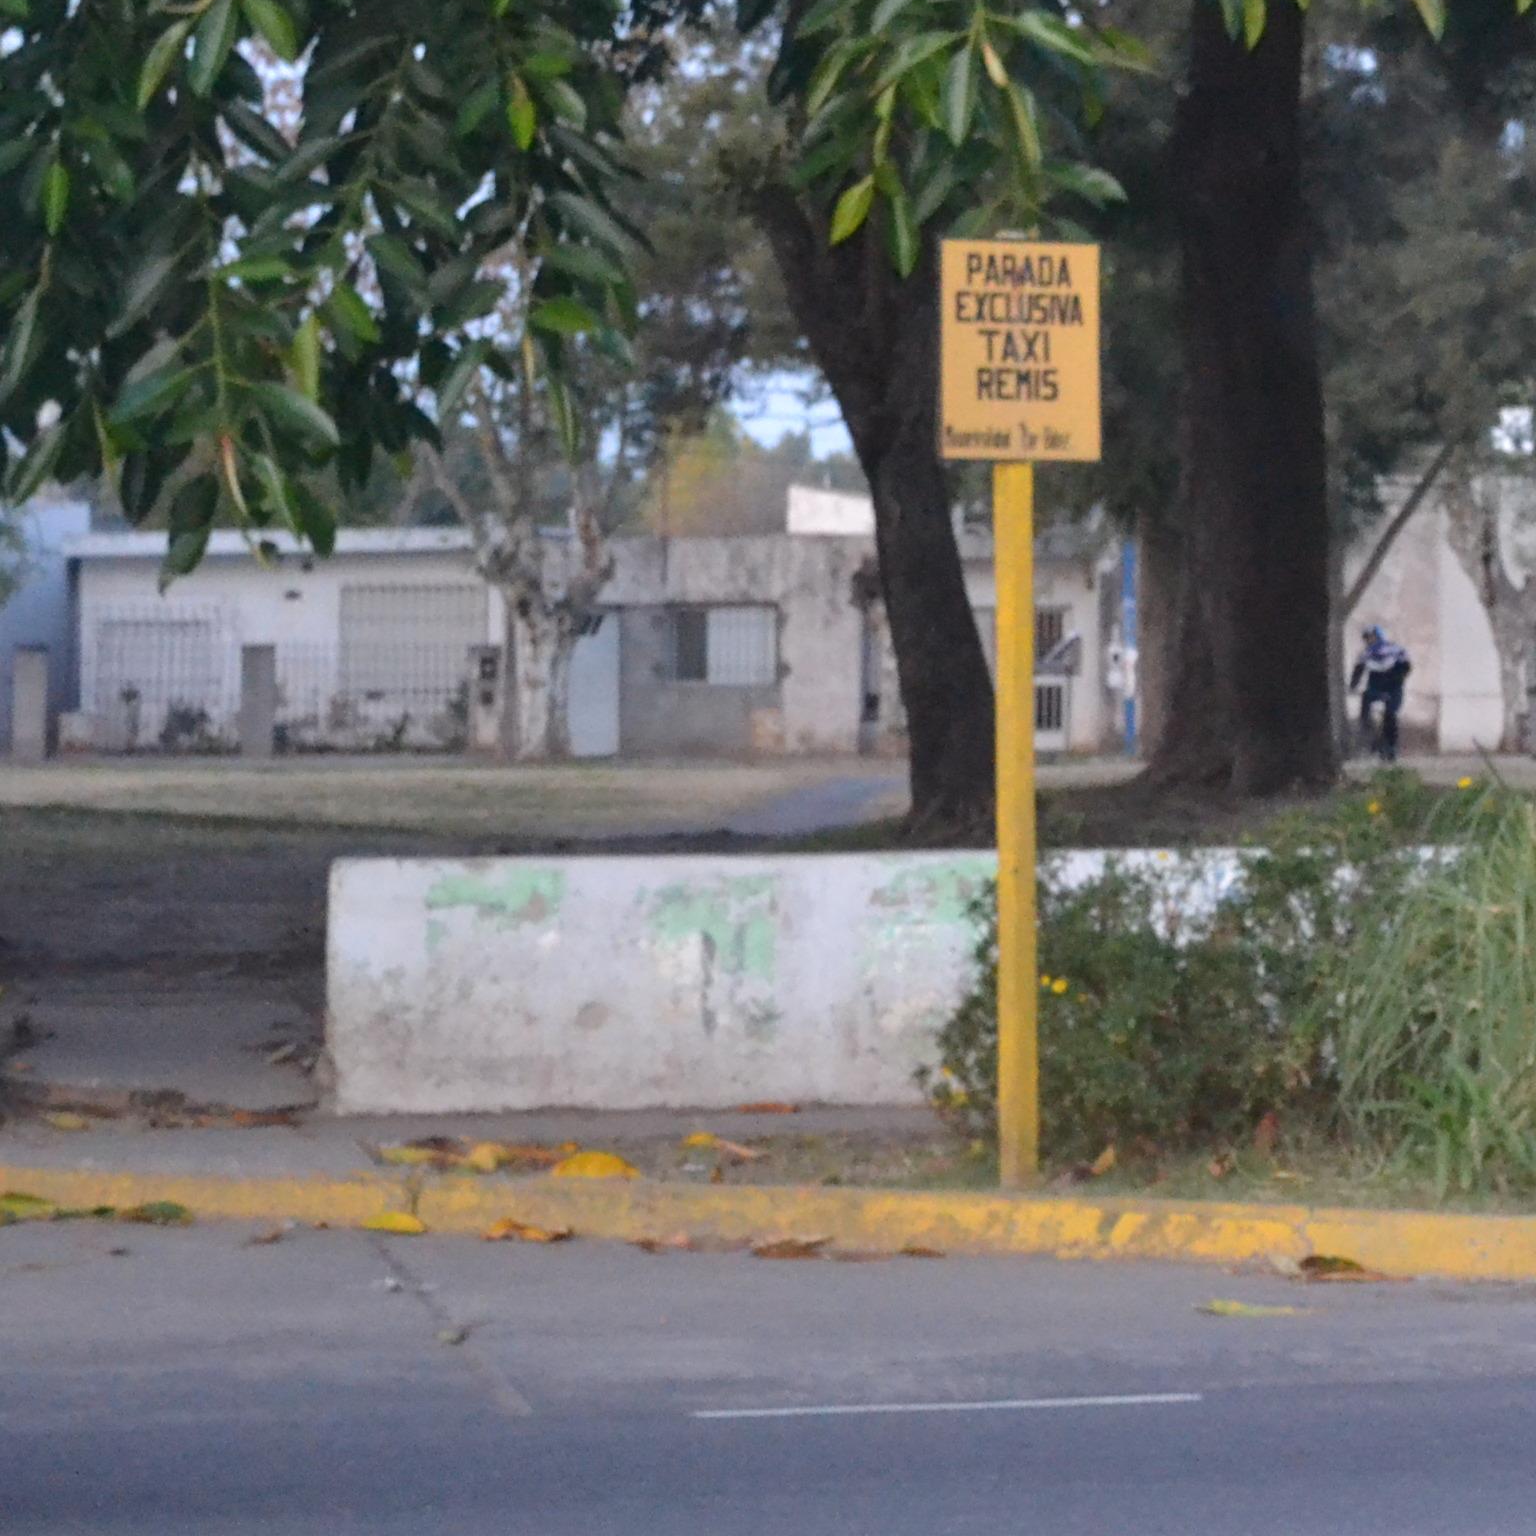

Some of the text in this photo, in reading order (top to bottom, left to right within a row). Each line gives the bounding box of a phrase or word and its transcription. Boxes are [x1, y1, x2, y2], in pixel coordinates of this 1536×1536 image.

[966, 252, 1073, 288] PARADA
[954, 290, 1085, 327] EXCLUSIVA
[977, 329, 1051, 363] TAXI
[976, 366, 1060, 401] REMIS
